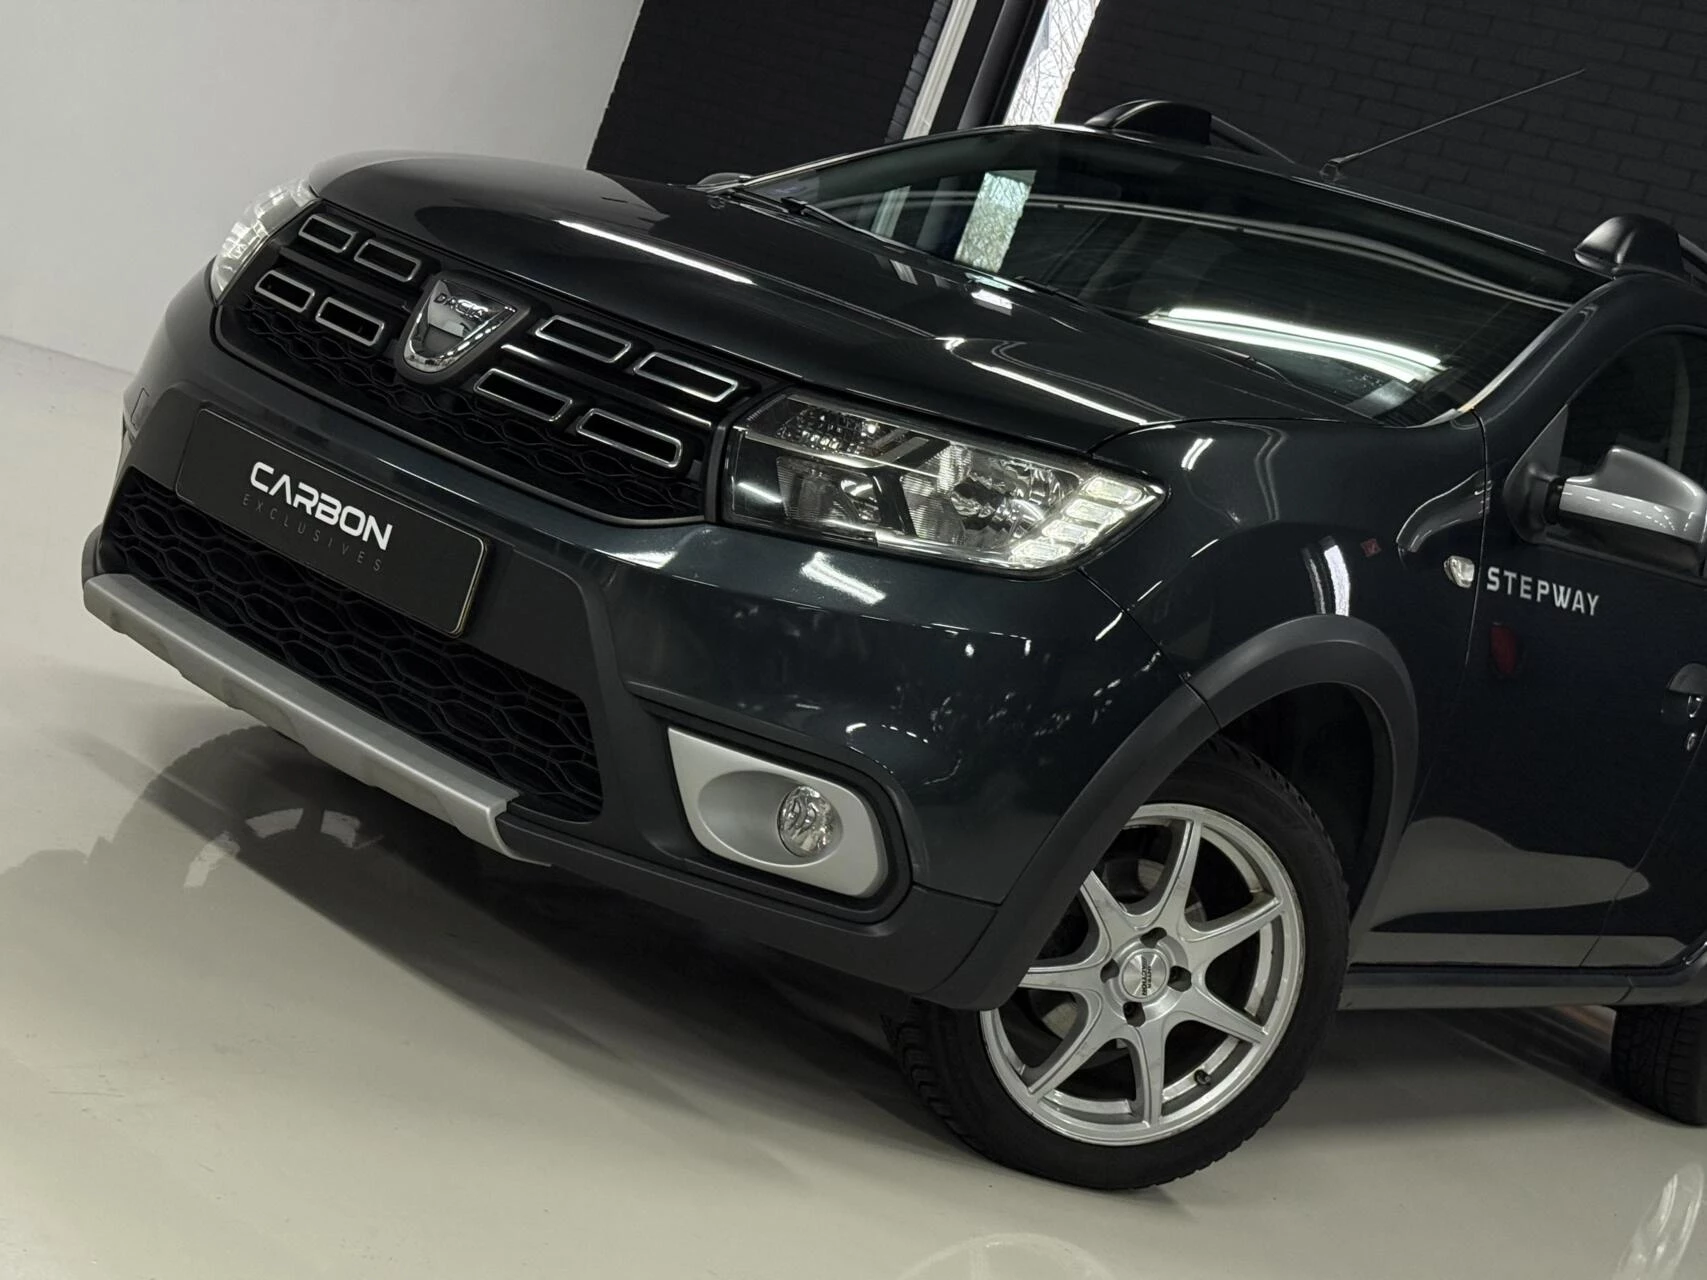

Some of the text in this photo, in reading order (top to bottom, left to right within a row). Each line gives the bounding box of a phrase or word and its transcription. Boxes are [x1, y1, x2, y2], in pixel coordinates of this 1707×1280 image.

[241, 493, 384, 573] EXCLUSIVES
[250, 461, 393, 551] CARBON
[1486, 566, 1600, 616] STEPWAY
